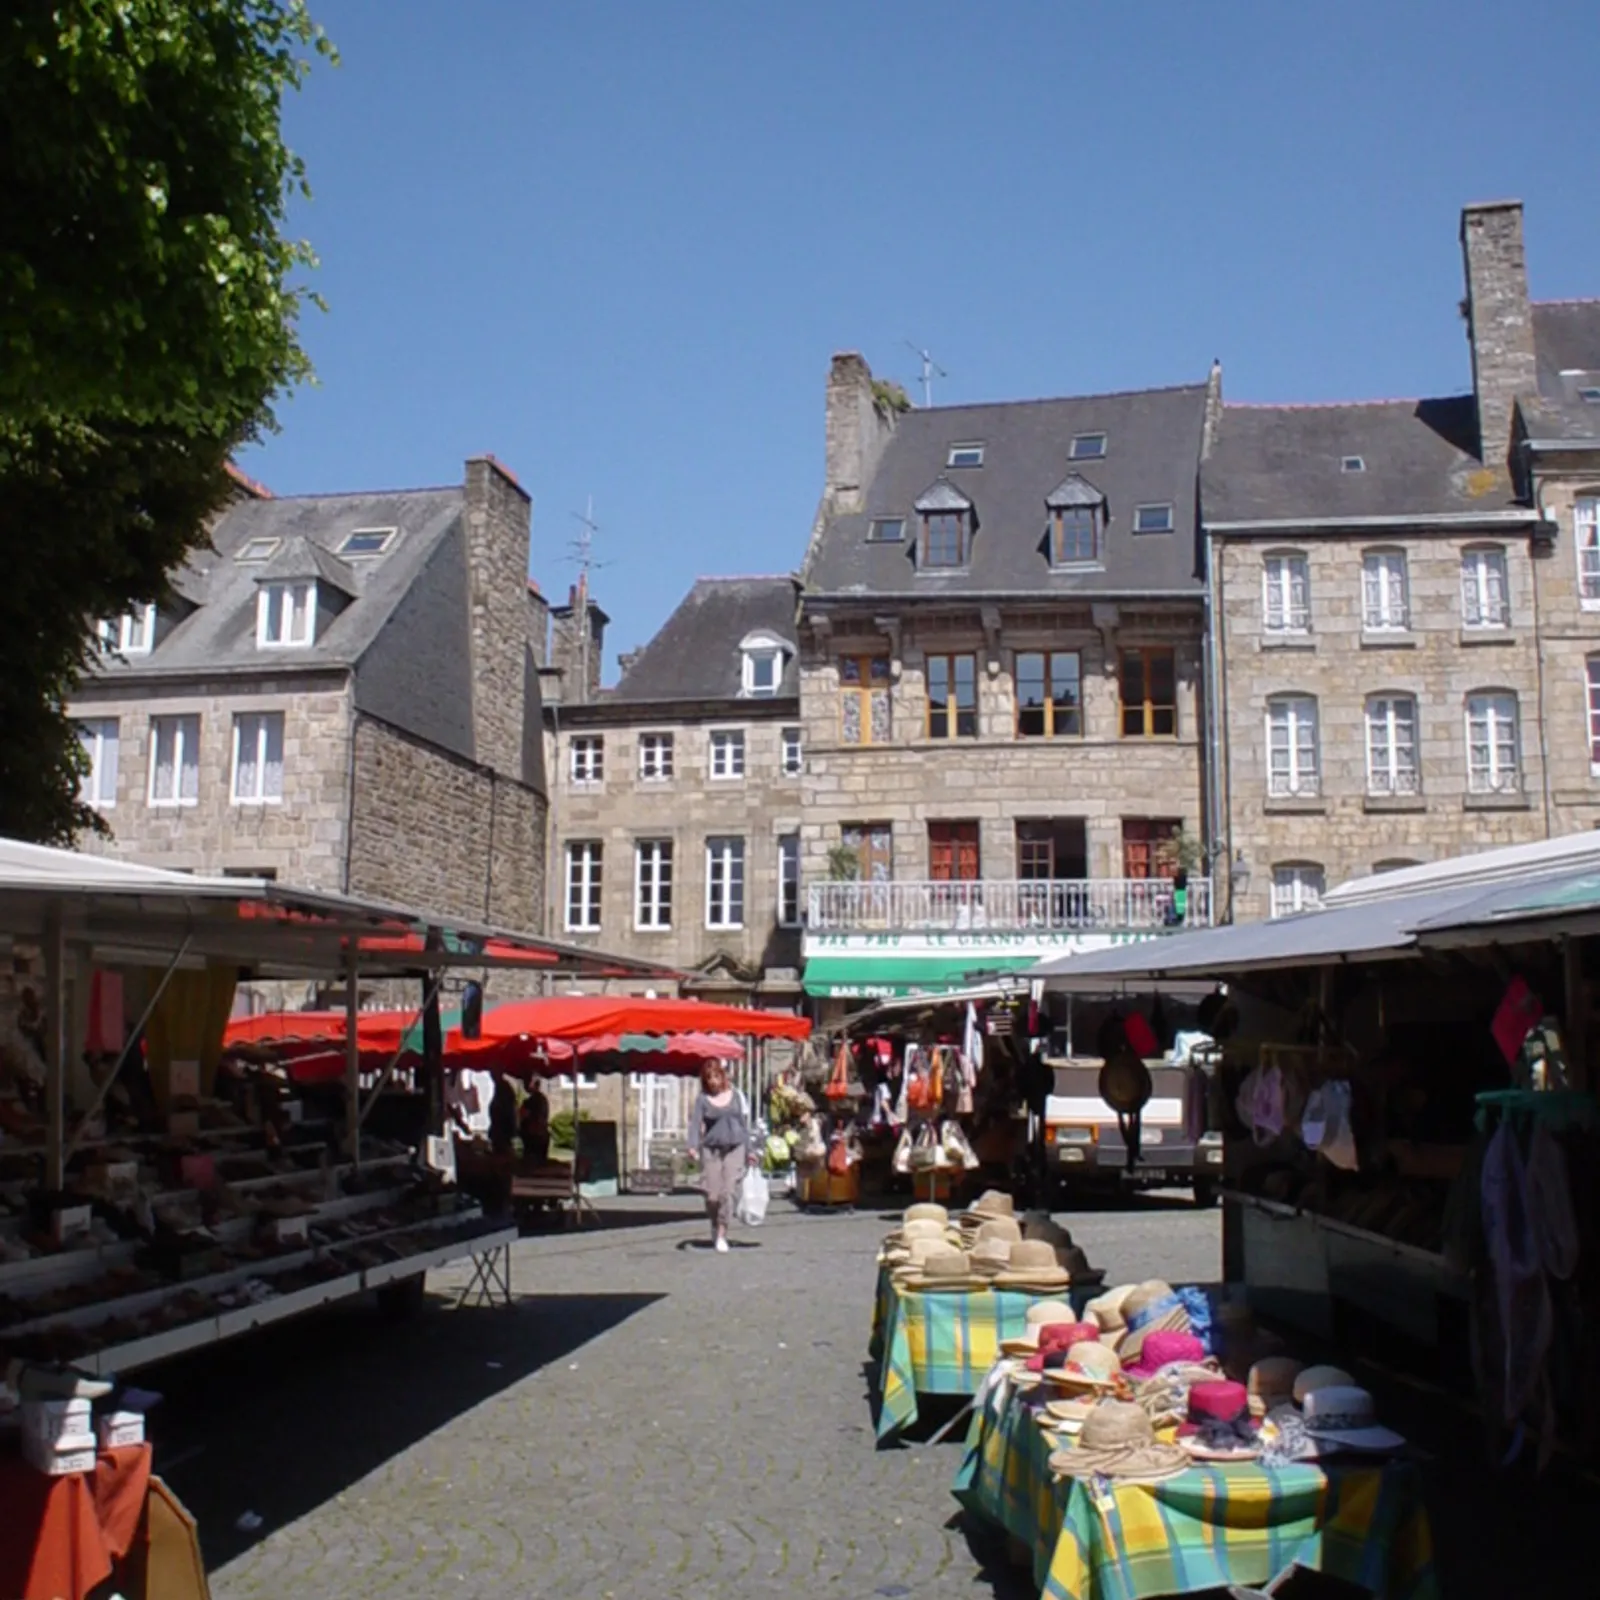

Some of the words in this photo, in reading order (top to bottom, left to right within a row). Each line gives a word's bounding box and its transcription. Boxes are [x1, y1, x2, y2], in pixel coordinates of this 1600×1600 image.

[818, 933, 849, 947] BAR
[866, 933, 901, 946] PMU
[925, 933, 946, 946] LE
[957, 932, 1023, 946] GRAND
